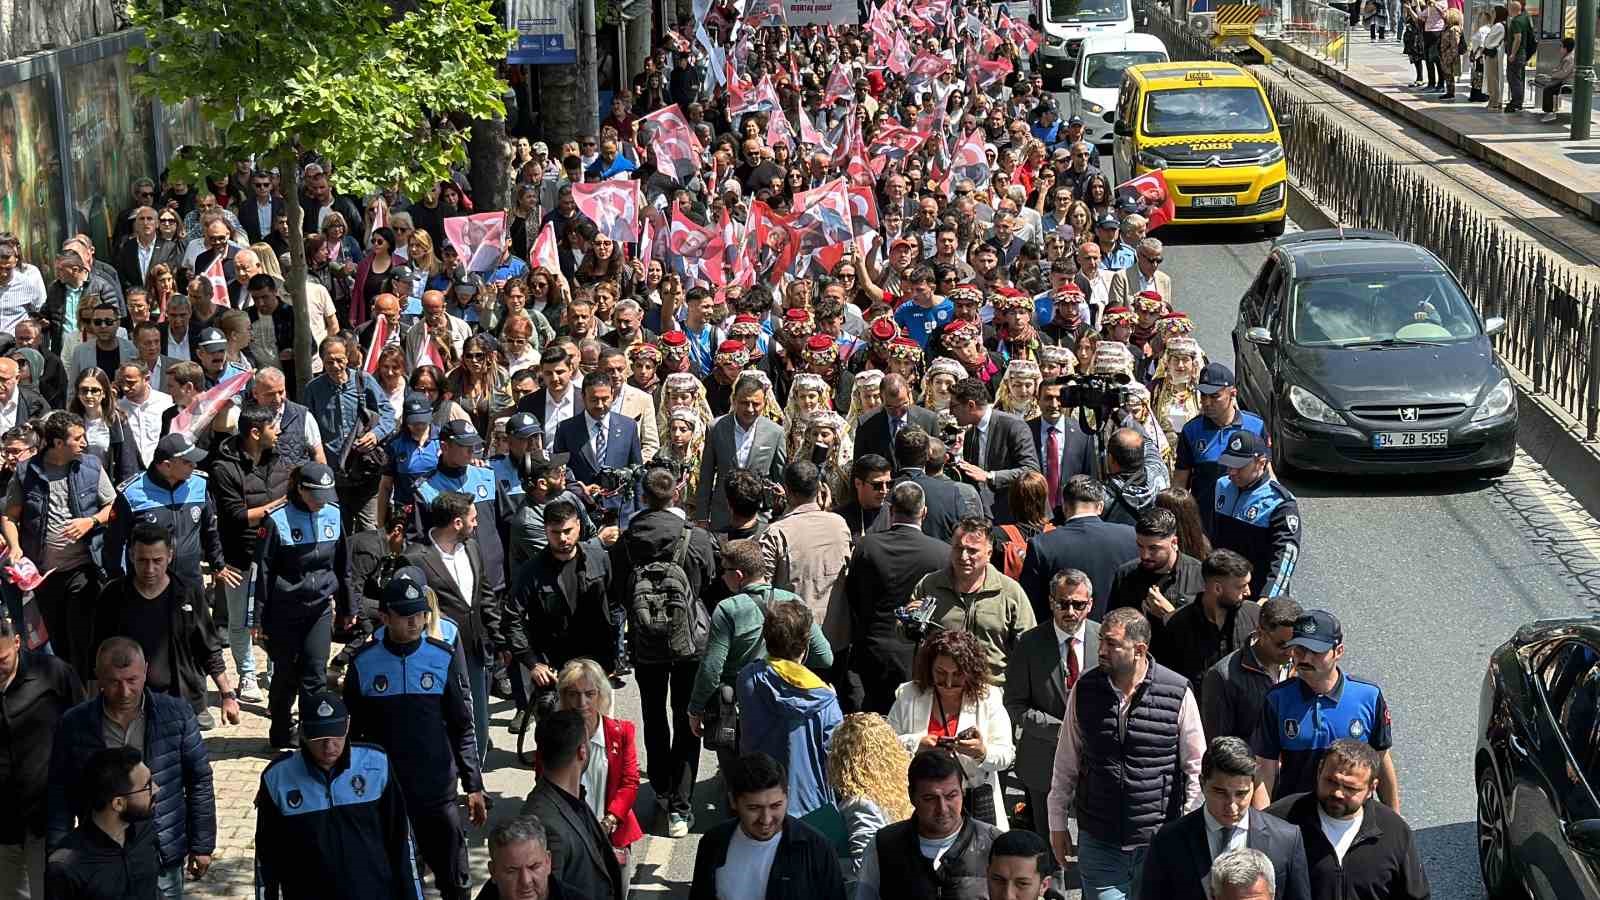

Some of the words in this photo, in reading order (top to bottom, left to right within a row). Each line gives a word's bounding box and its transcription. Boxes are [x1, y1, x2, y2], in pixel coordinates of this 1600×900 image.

[1380, 433, 1393, 445] 34
[1401, 433, 1416, 445] ZB
[1421, 432, 1446, 445] 5155
